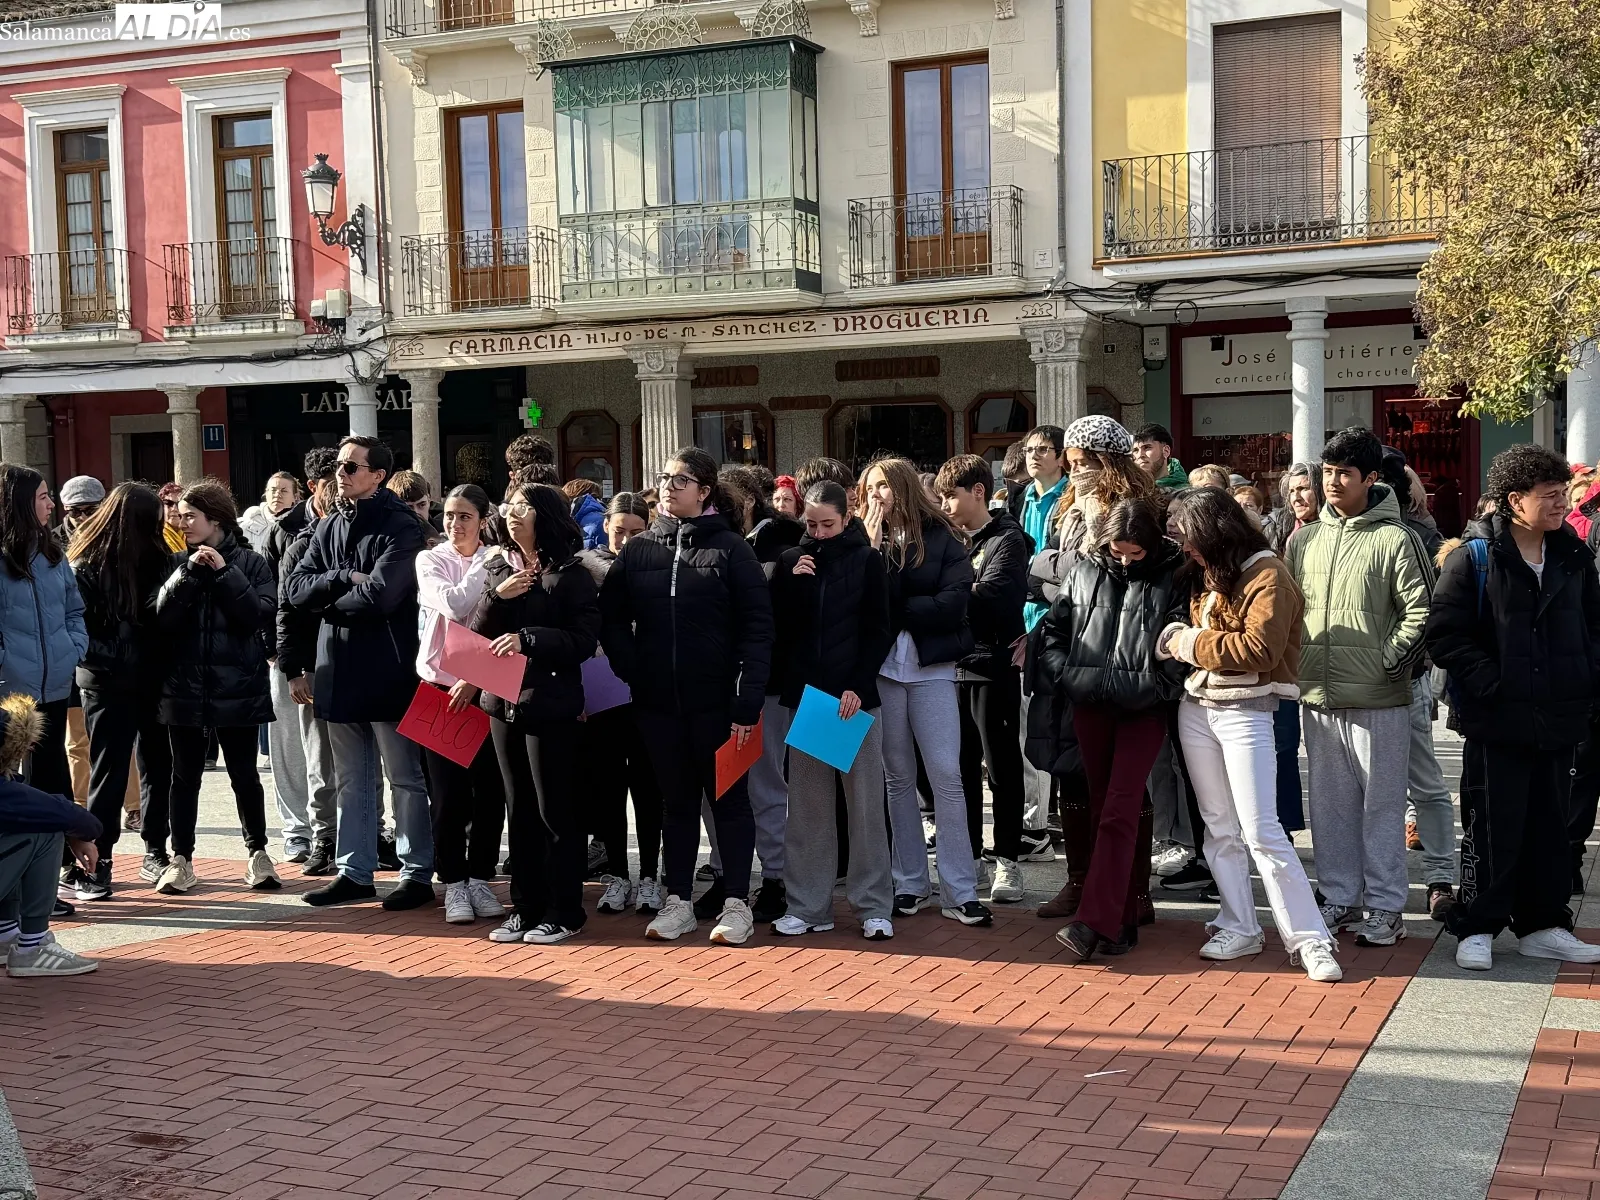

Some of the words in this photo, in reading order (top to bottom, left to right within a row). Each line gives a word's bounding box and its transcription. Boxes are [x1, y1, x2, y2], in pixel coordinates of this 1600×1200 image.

[448, 333, 573, 355] FARMACIA
[586, 330, 632, 344] HIJO
[644, 327, 668, 340] DE
[712, 320, 817, 337] SANCHEZ
[833, 307, 990, 332] DROGUERIA
[1221, 339, 1277, 366] José
[1322, 342, 1431, 361] utiérrez
[1337, 366, 1408, 380] charcute
